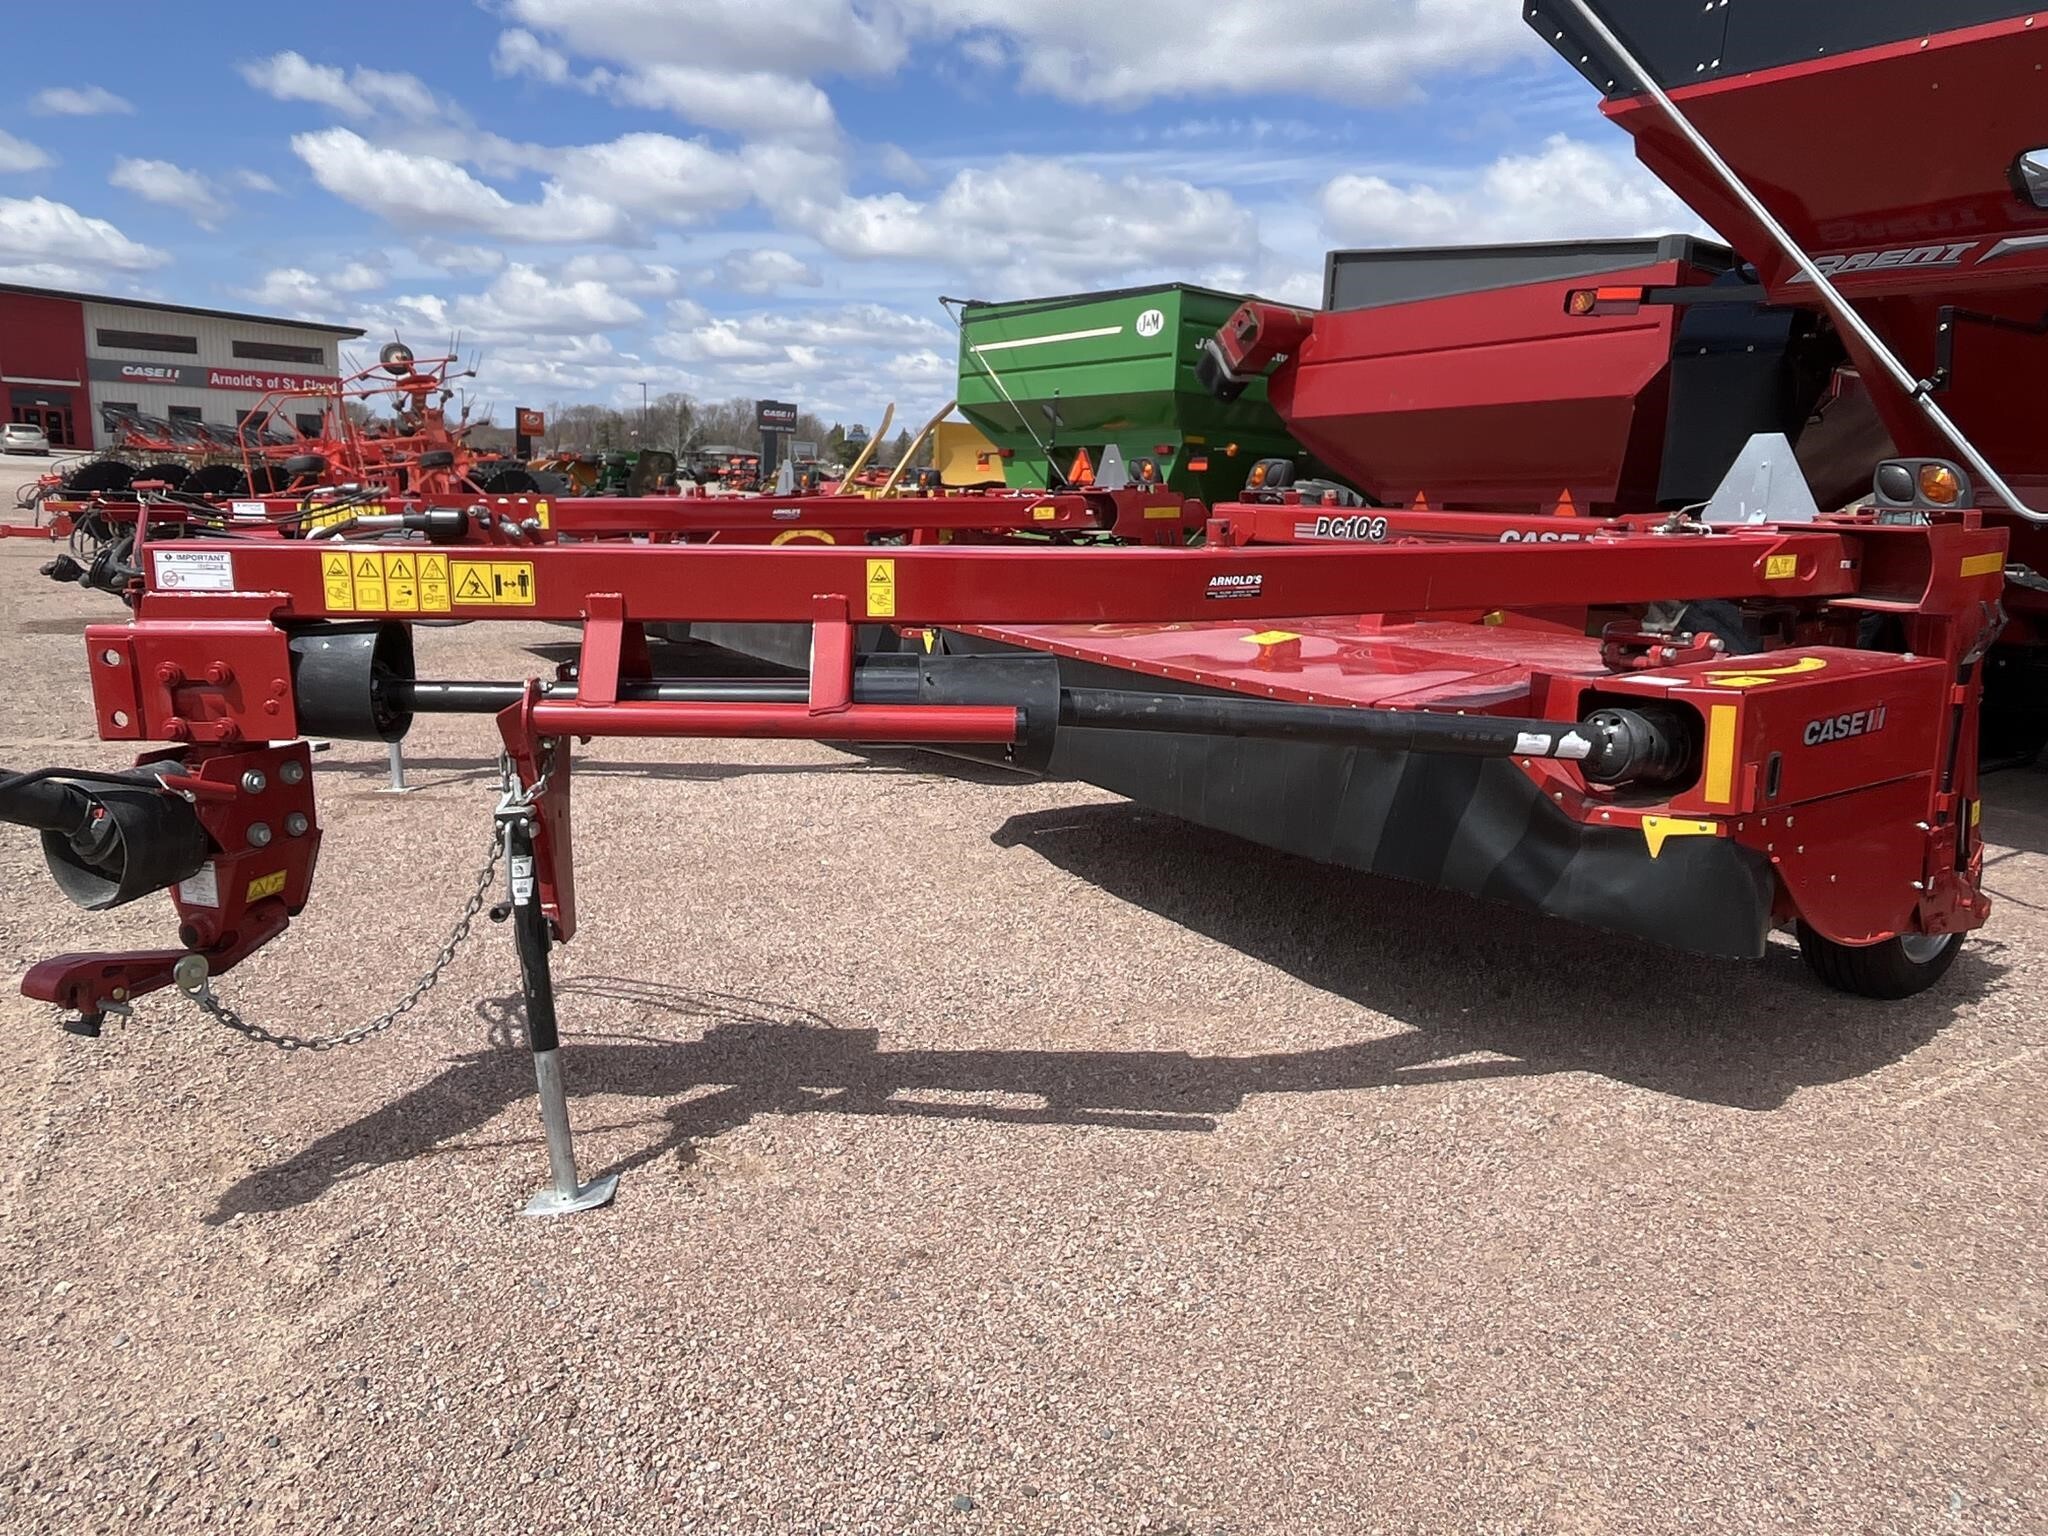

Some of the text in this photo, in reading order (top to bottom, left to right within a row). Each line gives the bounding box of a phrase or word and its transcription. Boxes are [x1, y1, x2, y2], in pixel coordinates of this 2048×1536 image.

[211, 372, 263, 388] Arnold's
[267, 378, 279, 390] of
[1315, 516, 1387, 541] DC103
[176, 554, 225, 562] IMPORTANT
[1209, 574, 1263, 587] ARNOLD'S
[1803, 711, 1867, 746] CASE
